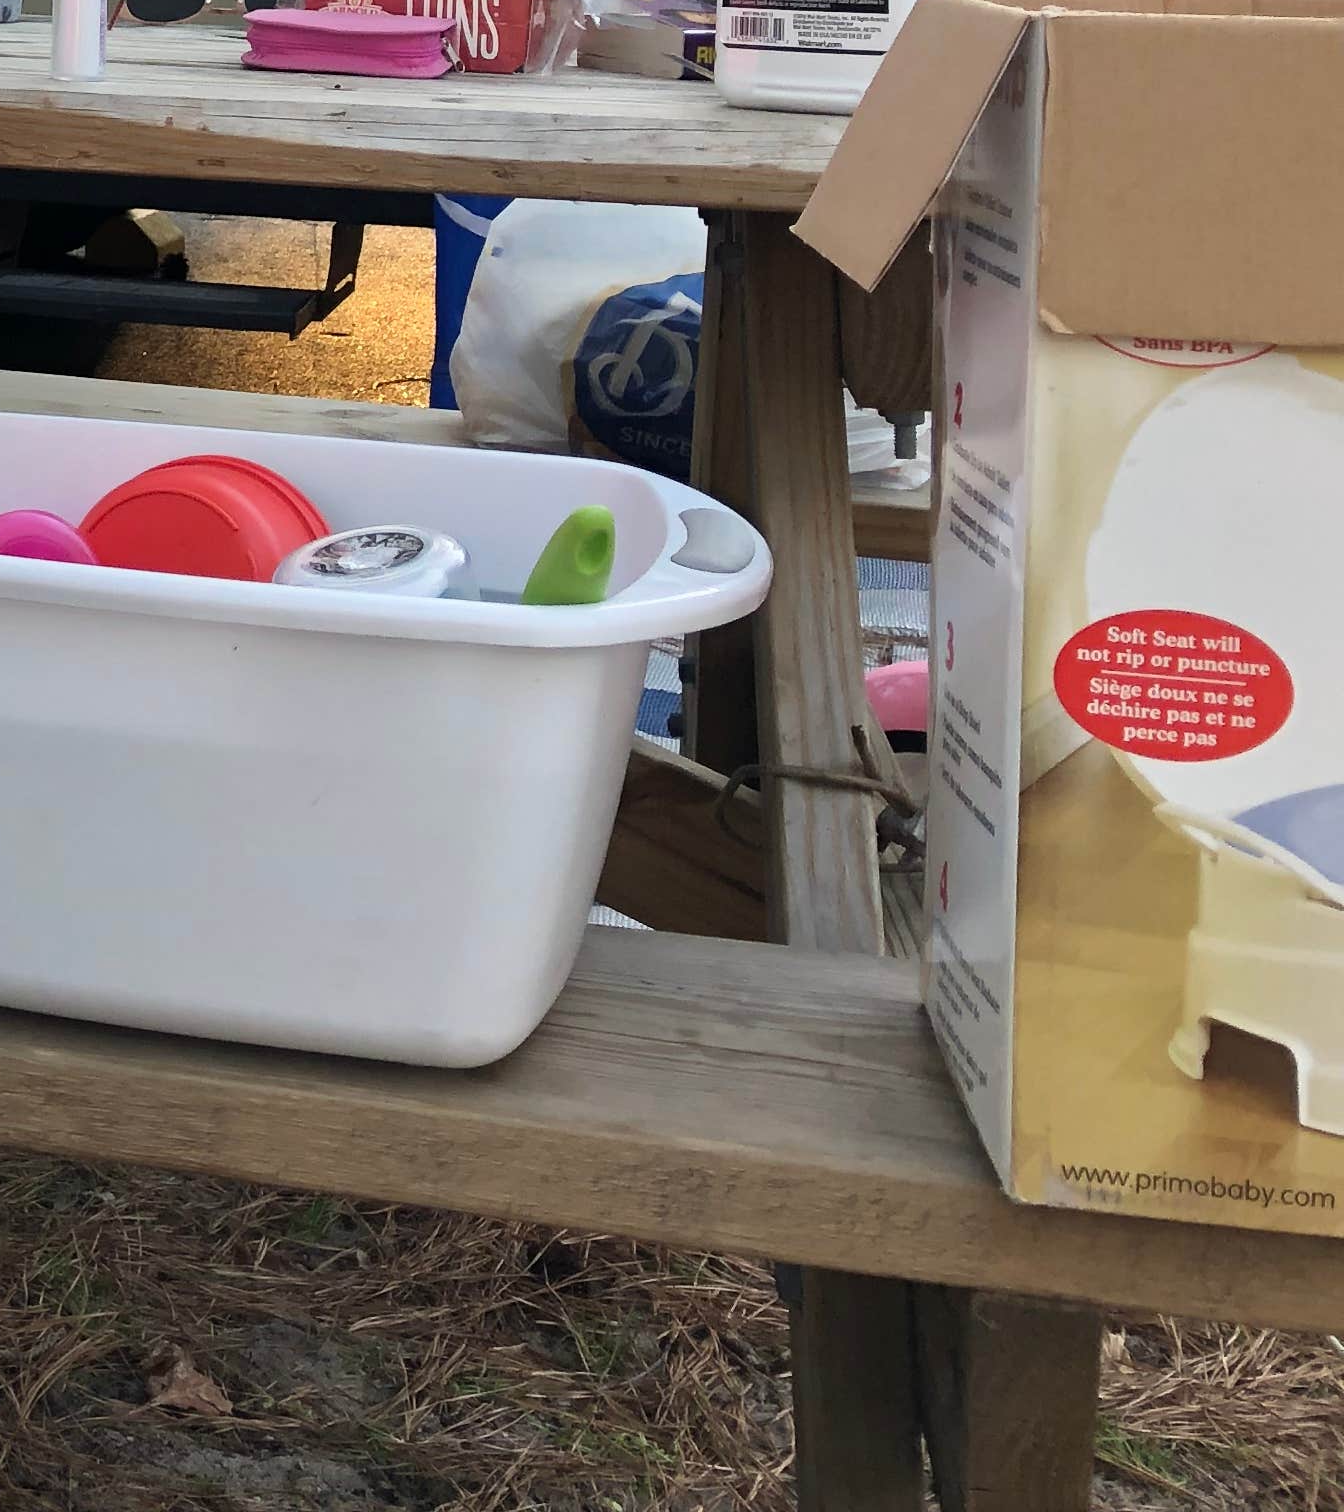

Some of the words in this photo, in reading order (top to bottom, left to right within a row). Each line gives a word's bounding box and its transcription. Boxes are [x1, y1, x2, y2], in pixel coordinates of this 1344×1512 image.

[1132, 336, 1184, 351] Sans
[953, 381, 963, 429] 2
[945, 620, 954, 672] 3
[1107, 626, 1148, 645] Soft
[1153, 630, 1197, 649] Seat
[1203, 635, 1241, 653] will
[1077, 646, 1111, 663] not
[1116, 648, 1145, 668] rip
[1150, 653, 1172, 668] or
[1177, 656, 1270, 676] puncture
[1089, 676, 1142, 700] Siège
[1147, 683, 1198, 703] doux
[1203, 690, 1228, 705] ne
[1233, 692, 1254, 707] se
[1087, 699, 1161, 719] déchire
[1166, 709, 1200, 725] pas
[1206, 710, 1226, 726] et
[1231, 713, 1256, 728] ne
[1123, 725, 1177, 742] perce
[1183, 730, 1218, 748] pas
[1061, 1163, 1336, 1210] www.primobaby.com
